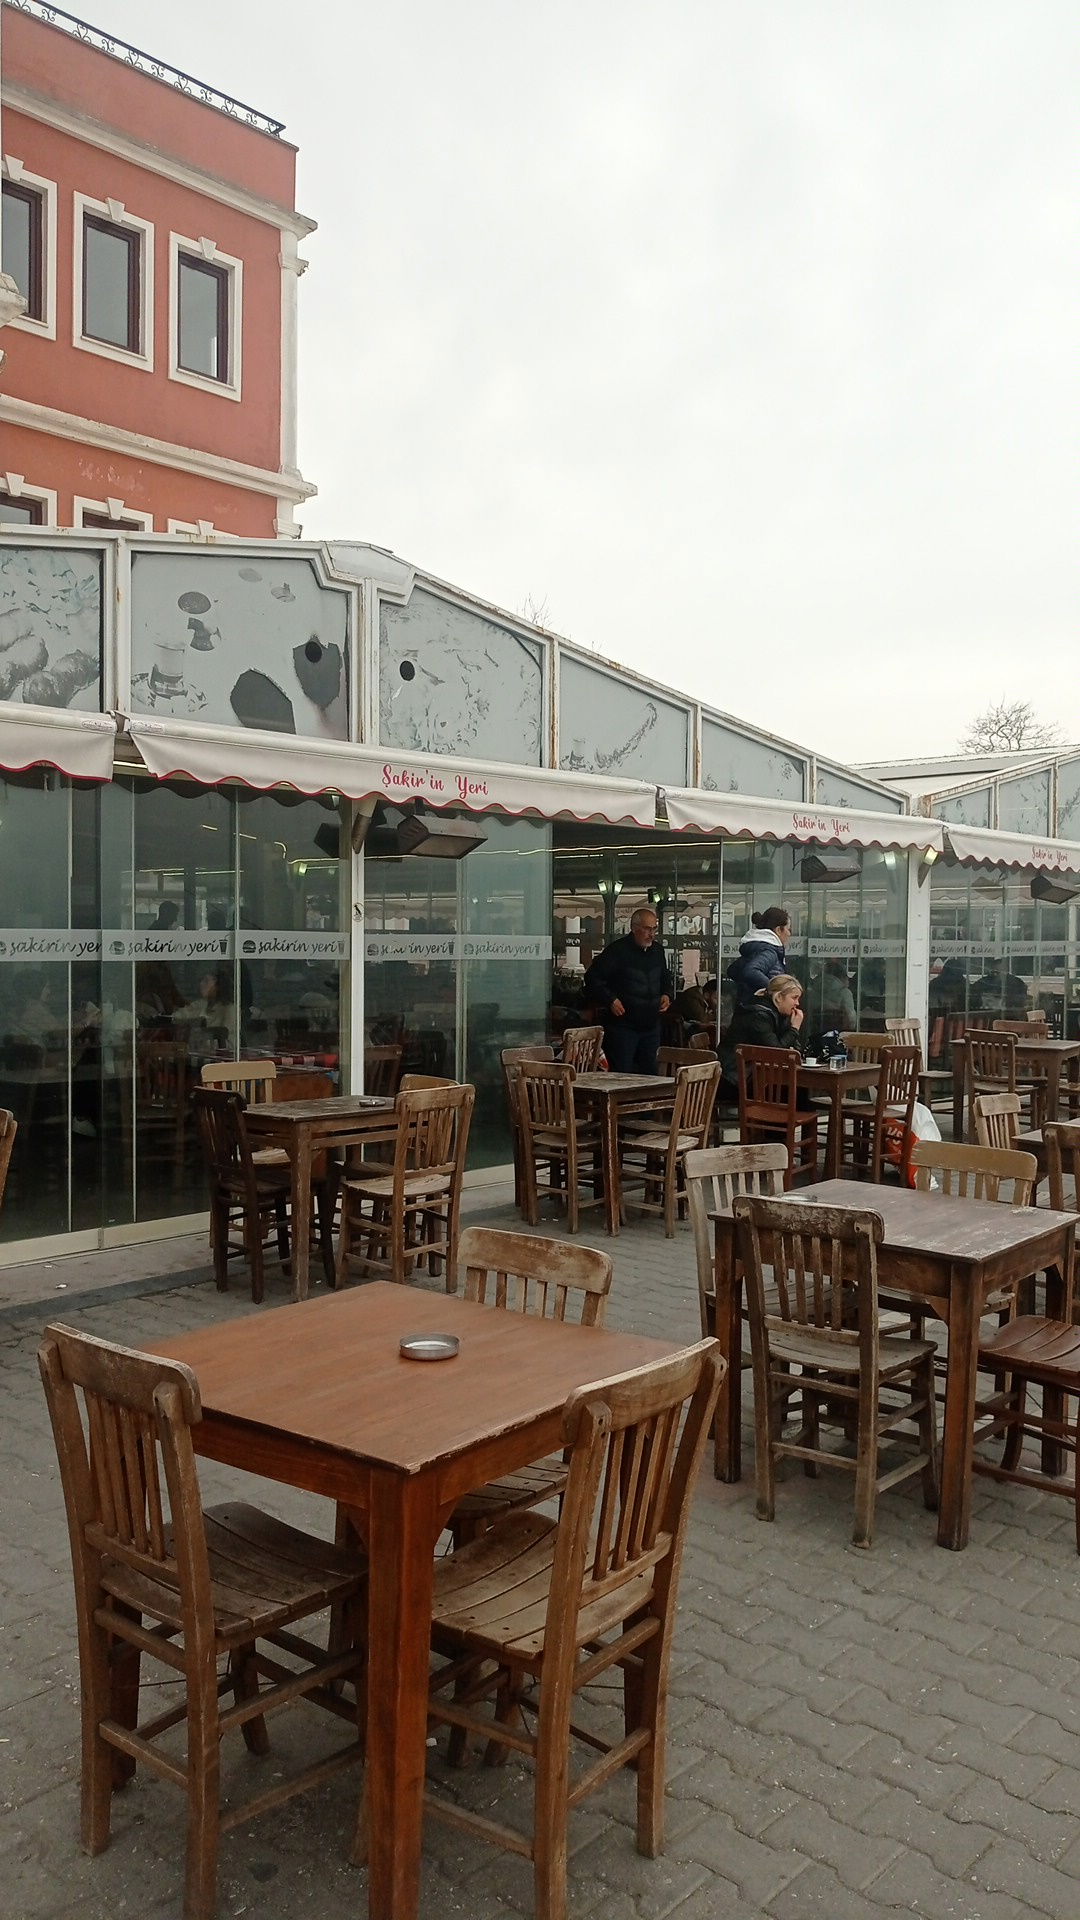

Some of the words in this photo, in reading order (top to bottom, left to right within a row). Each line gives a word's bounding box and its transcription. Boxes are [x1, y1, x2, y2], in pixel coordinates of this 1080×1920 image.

[382, 764, 444, 791] Şakir'in
[455, 774, 488, 799] Yeri
[832, 818, 850, 836] Yeri
[76, 941, 102, 957] yer
